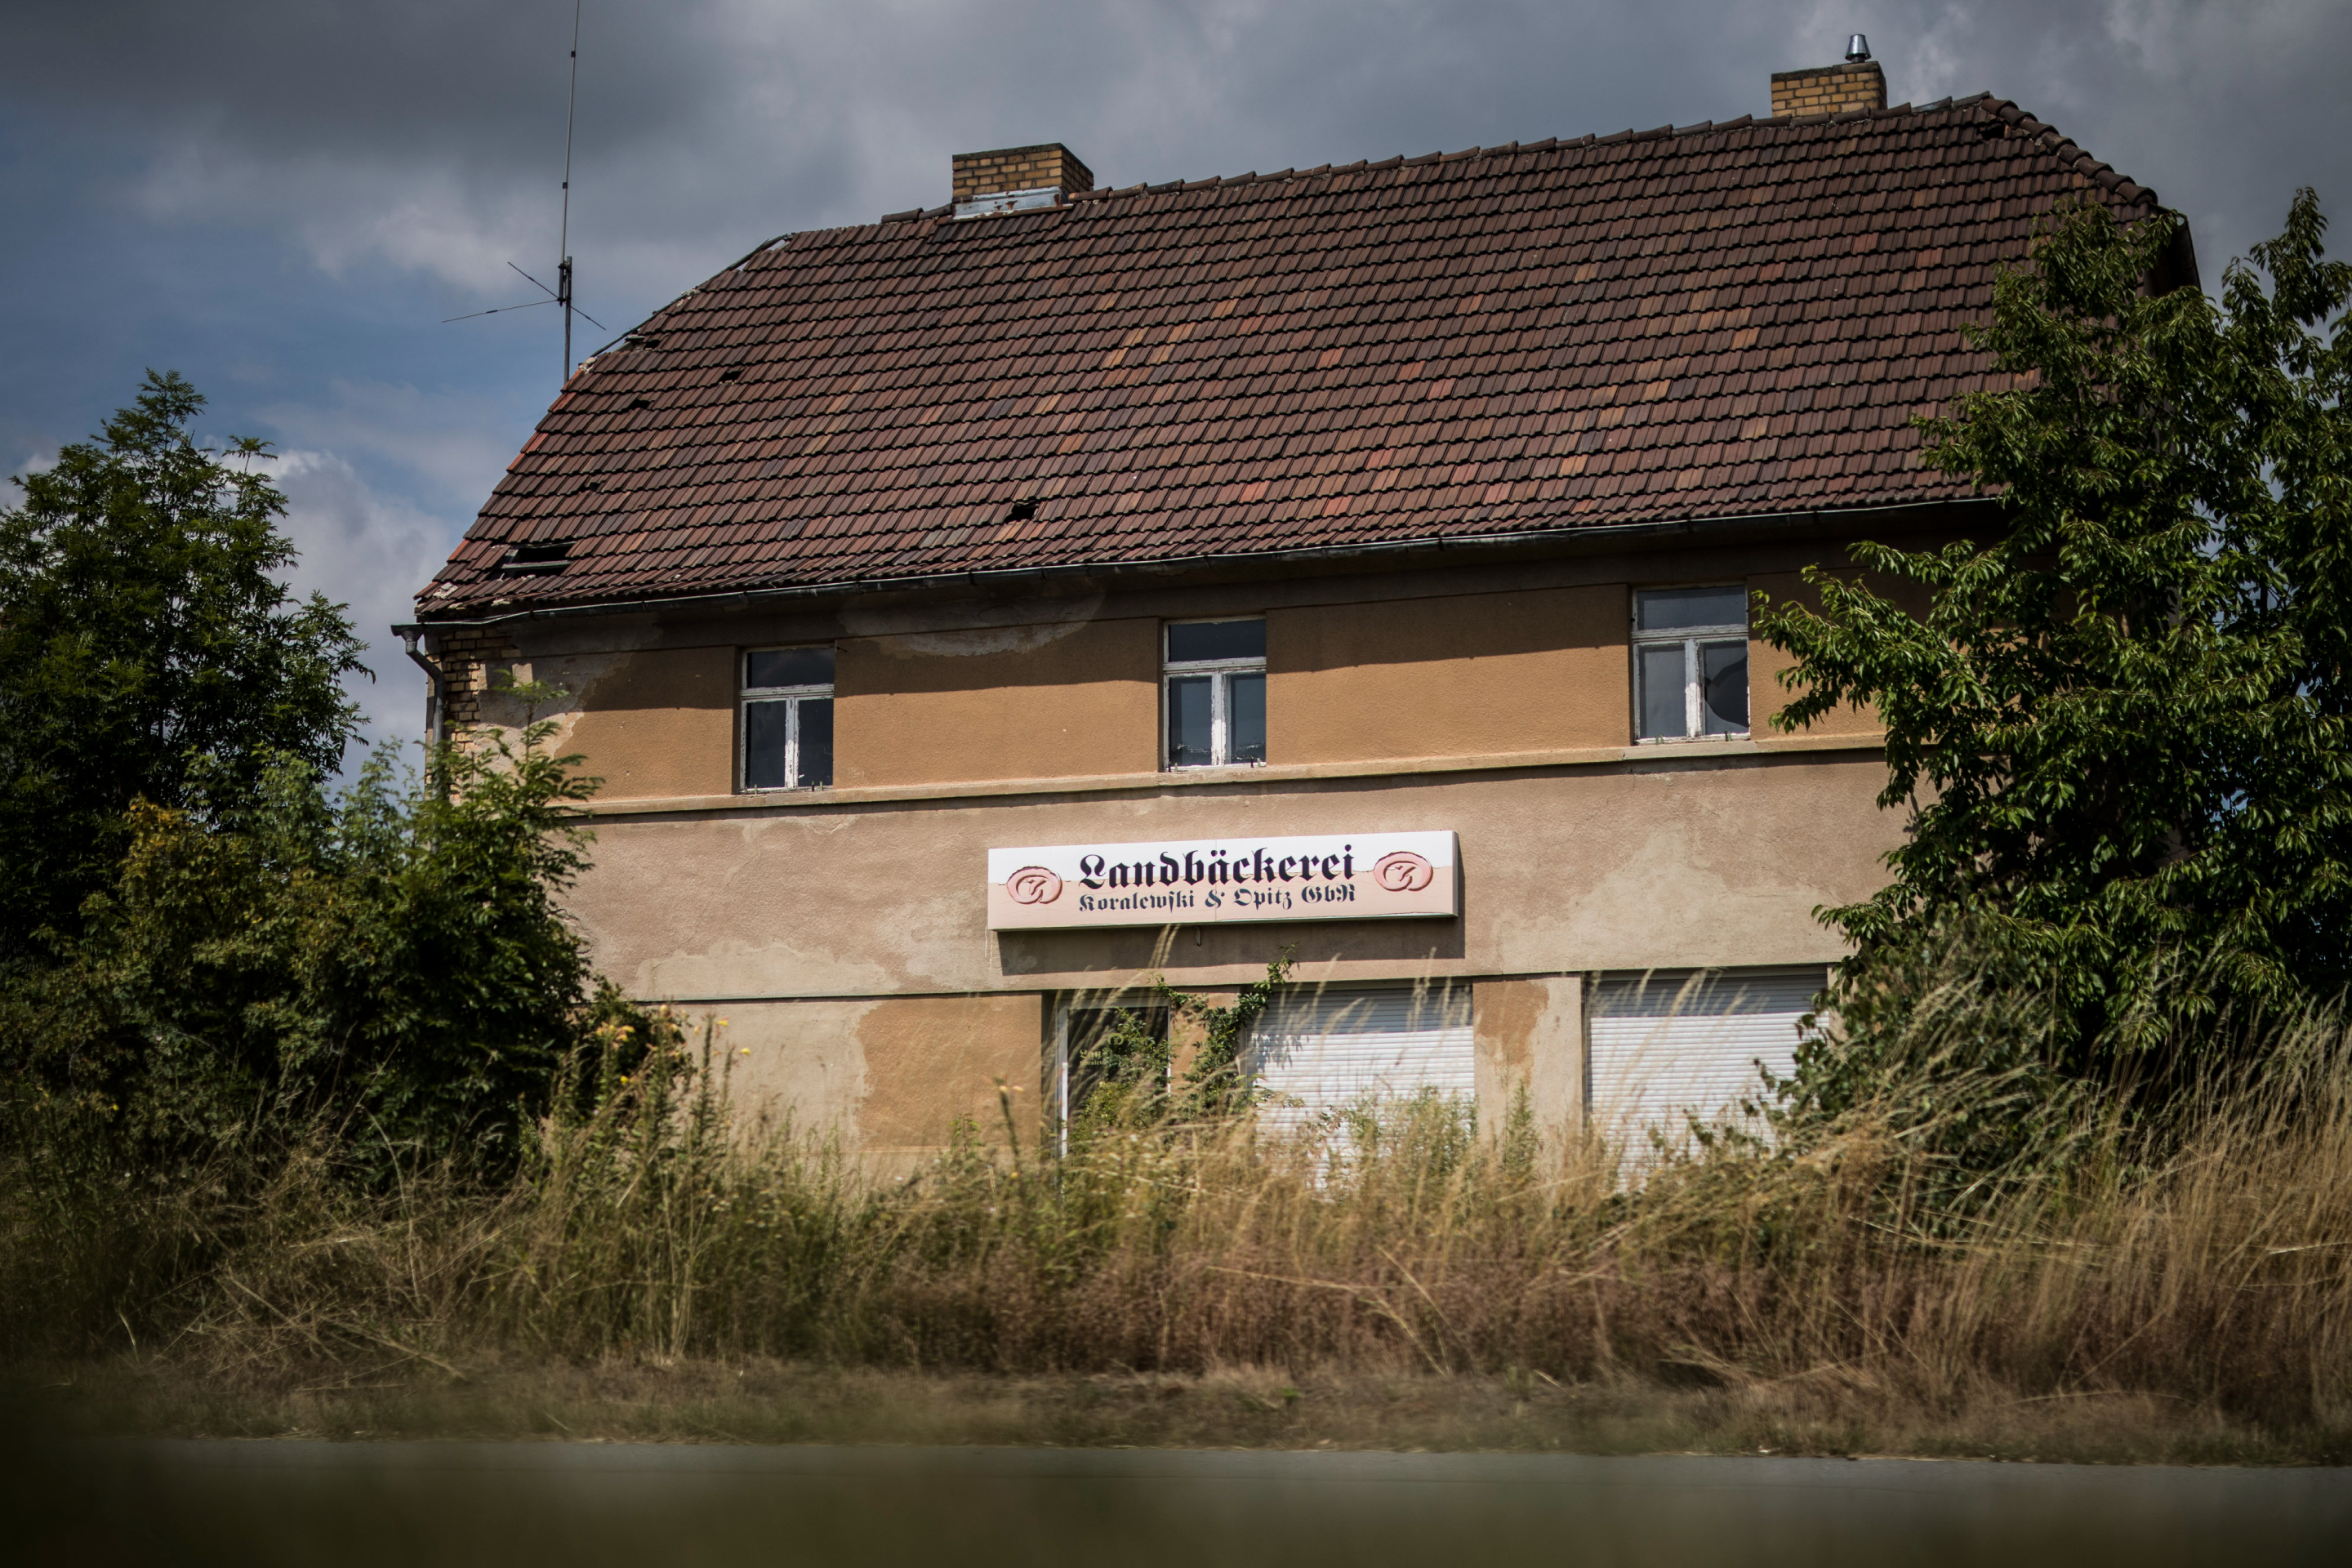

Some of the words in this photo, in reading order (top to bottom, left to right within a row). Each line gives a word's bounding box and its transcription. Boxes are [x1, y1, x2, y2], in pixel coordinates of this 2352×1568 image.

[1078, 844, 1356, 890] Landbäckerei
[1205, 889, 1226, 909] &
[1232, 887, 1293, 911] Opitz
[1301, 884, 1356, 904] GbR
